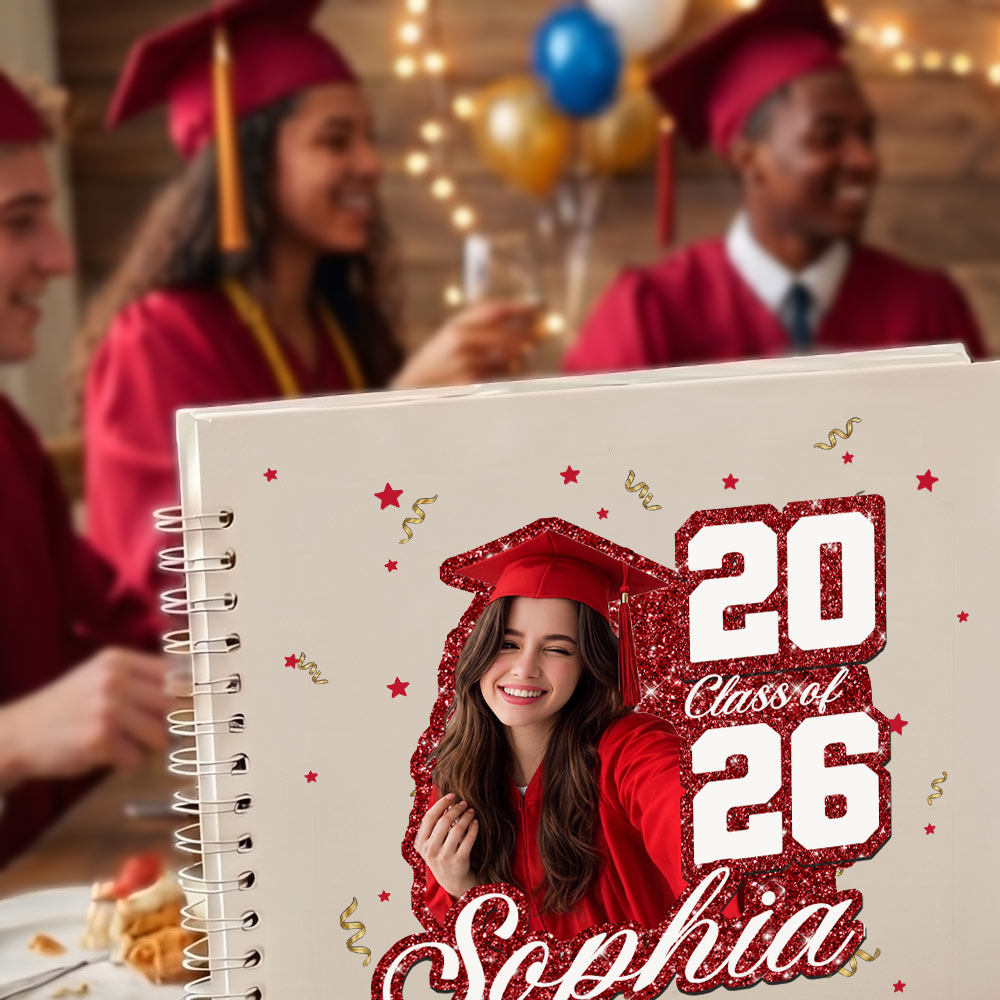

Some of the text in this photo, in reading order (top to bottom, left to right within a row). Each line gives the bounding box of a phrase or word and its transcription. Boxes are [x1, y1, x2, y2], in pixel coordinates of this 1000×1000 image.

[685, 510, 877, 664] 20
[684, 667, 850, 719] Class of
[690, 711, 881, 867] 26
